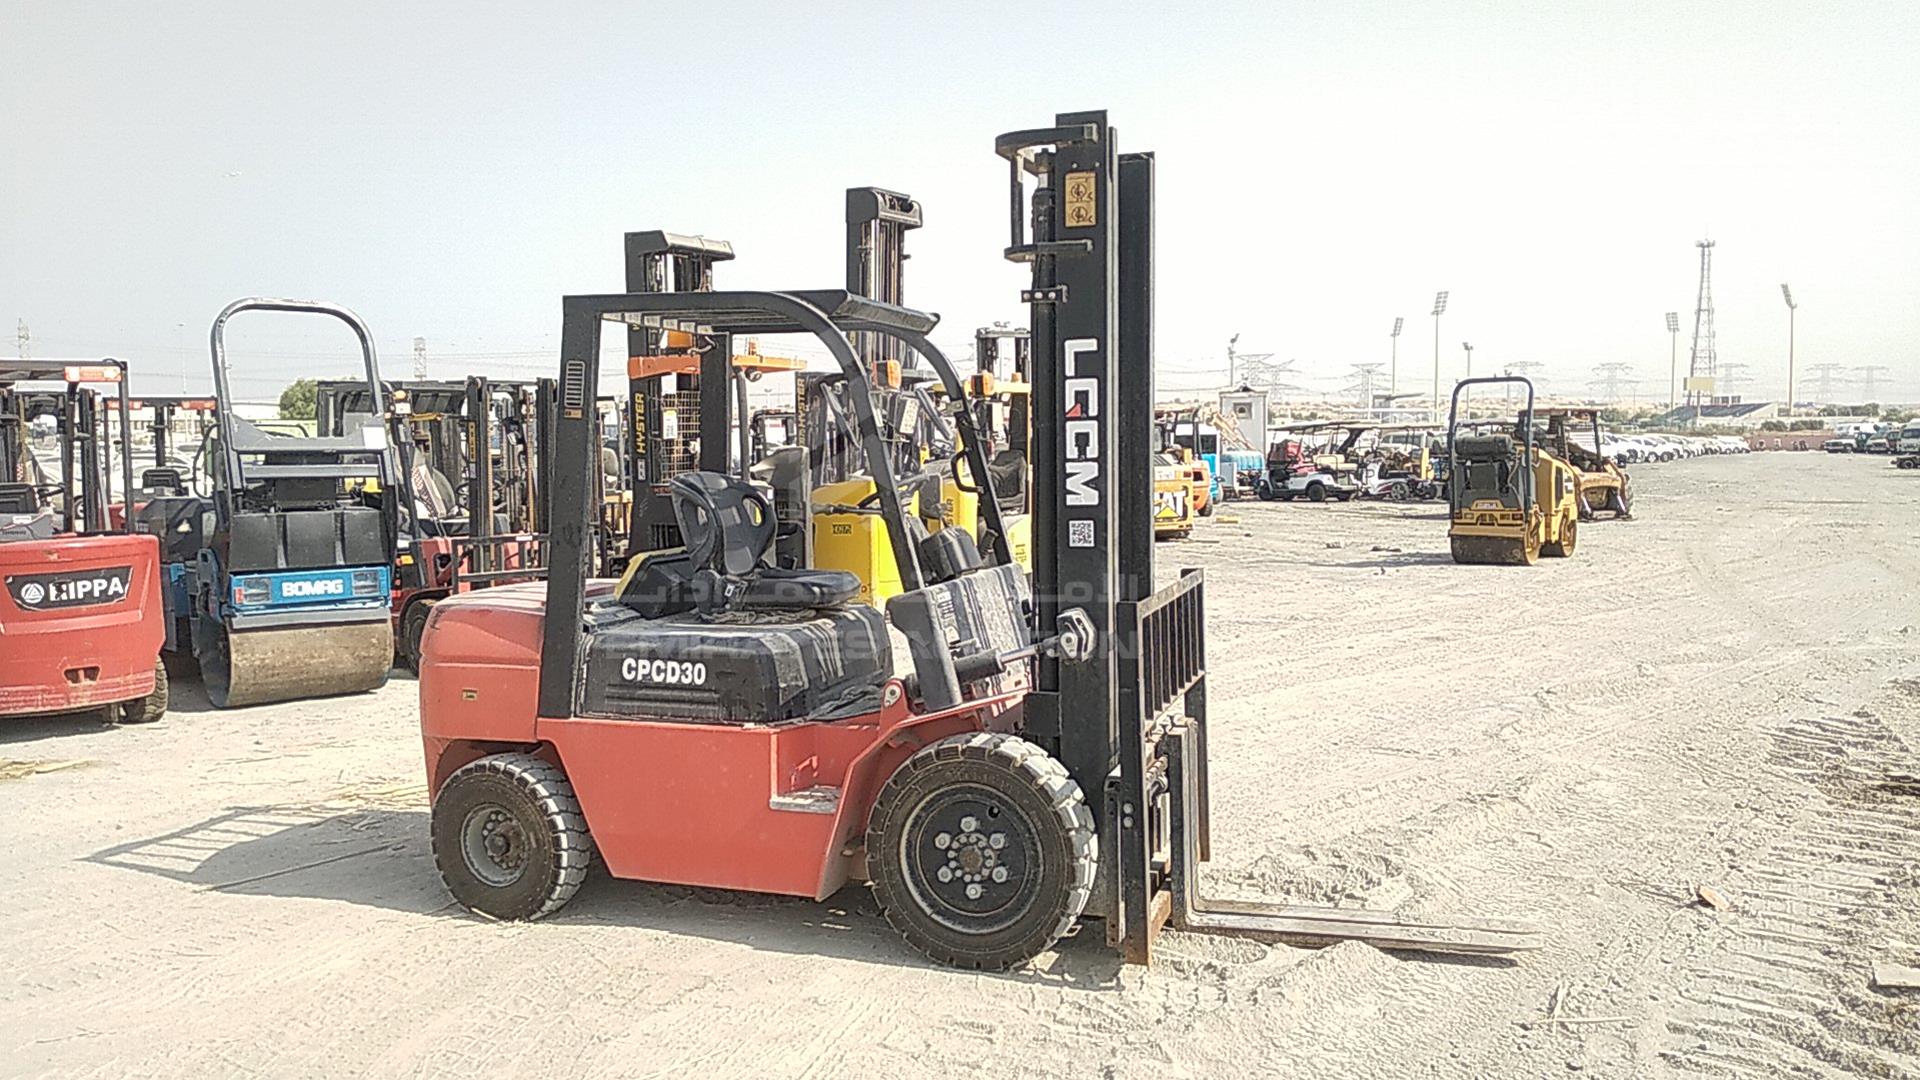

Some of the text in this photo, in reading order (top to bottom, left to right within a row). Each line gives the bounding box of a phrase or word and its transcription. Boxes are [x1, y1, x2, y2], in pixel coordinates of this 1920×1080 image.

[797, 377, 806, 429] HYSTER
[634, 392, 646, 454] HYSTER
[945, 498, 955, 527] STER
[281, 579, 344, 598] BOMAG
[622, 657, 707, 686] CPCD30
